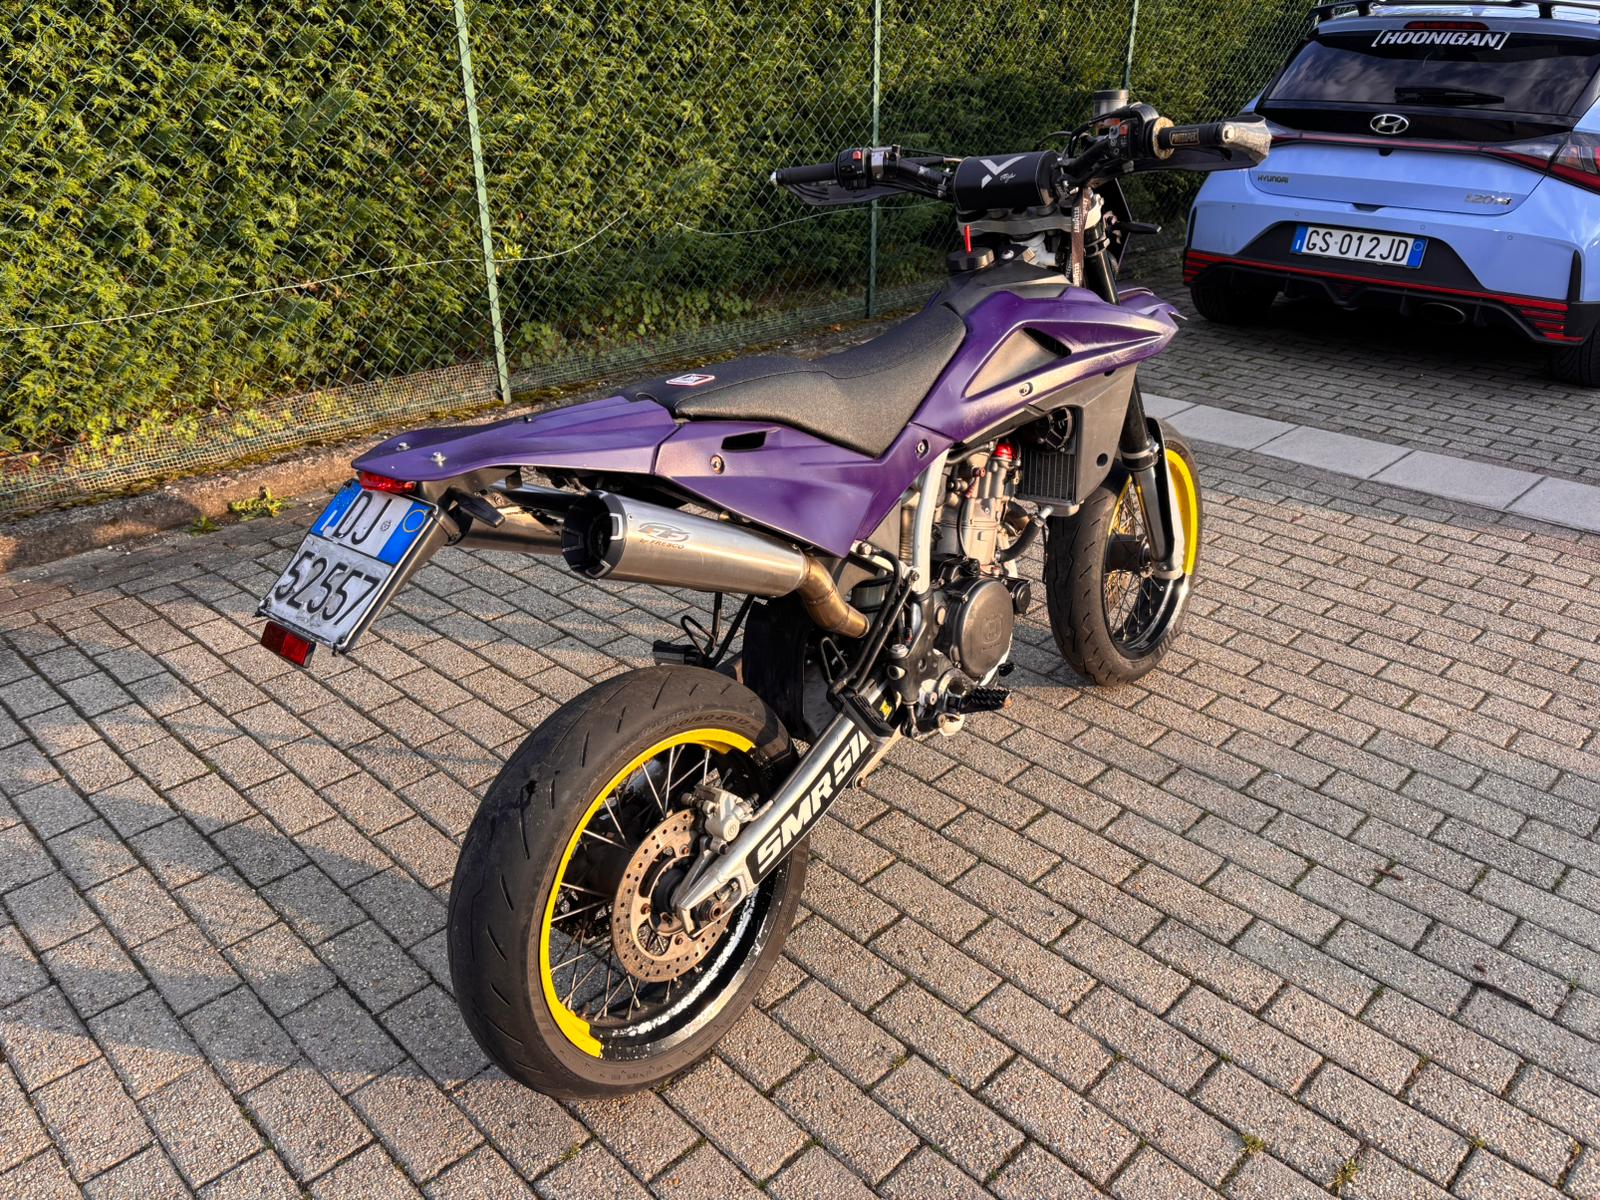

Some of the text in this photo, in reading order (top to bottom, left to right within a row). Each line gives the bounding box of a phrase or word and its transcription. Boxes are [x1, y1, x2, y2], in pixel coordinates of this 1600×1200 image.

[1257, 174, 1289, 184] HYUNDAI
[333, 490, 393, 545] DJ
[274, 550, 382, 626] 52557
[757, 771, 834, 874] SMR
